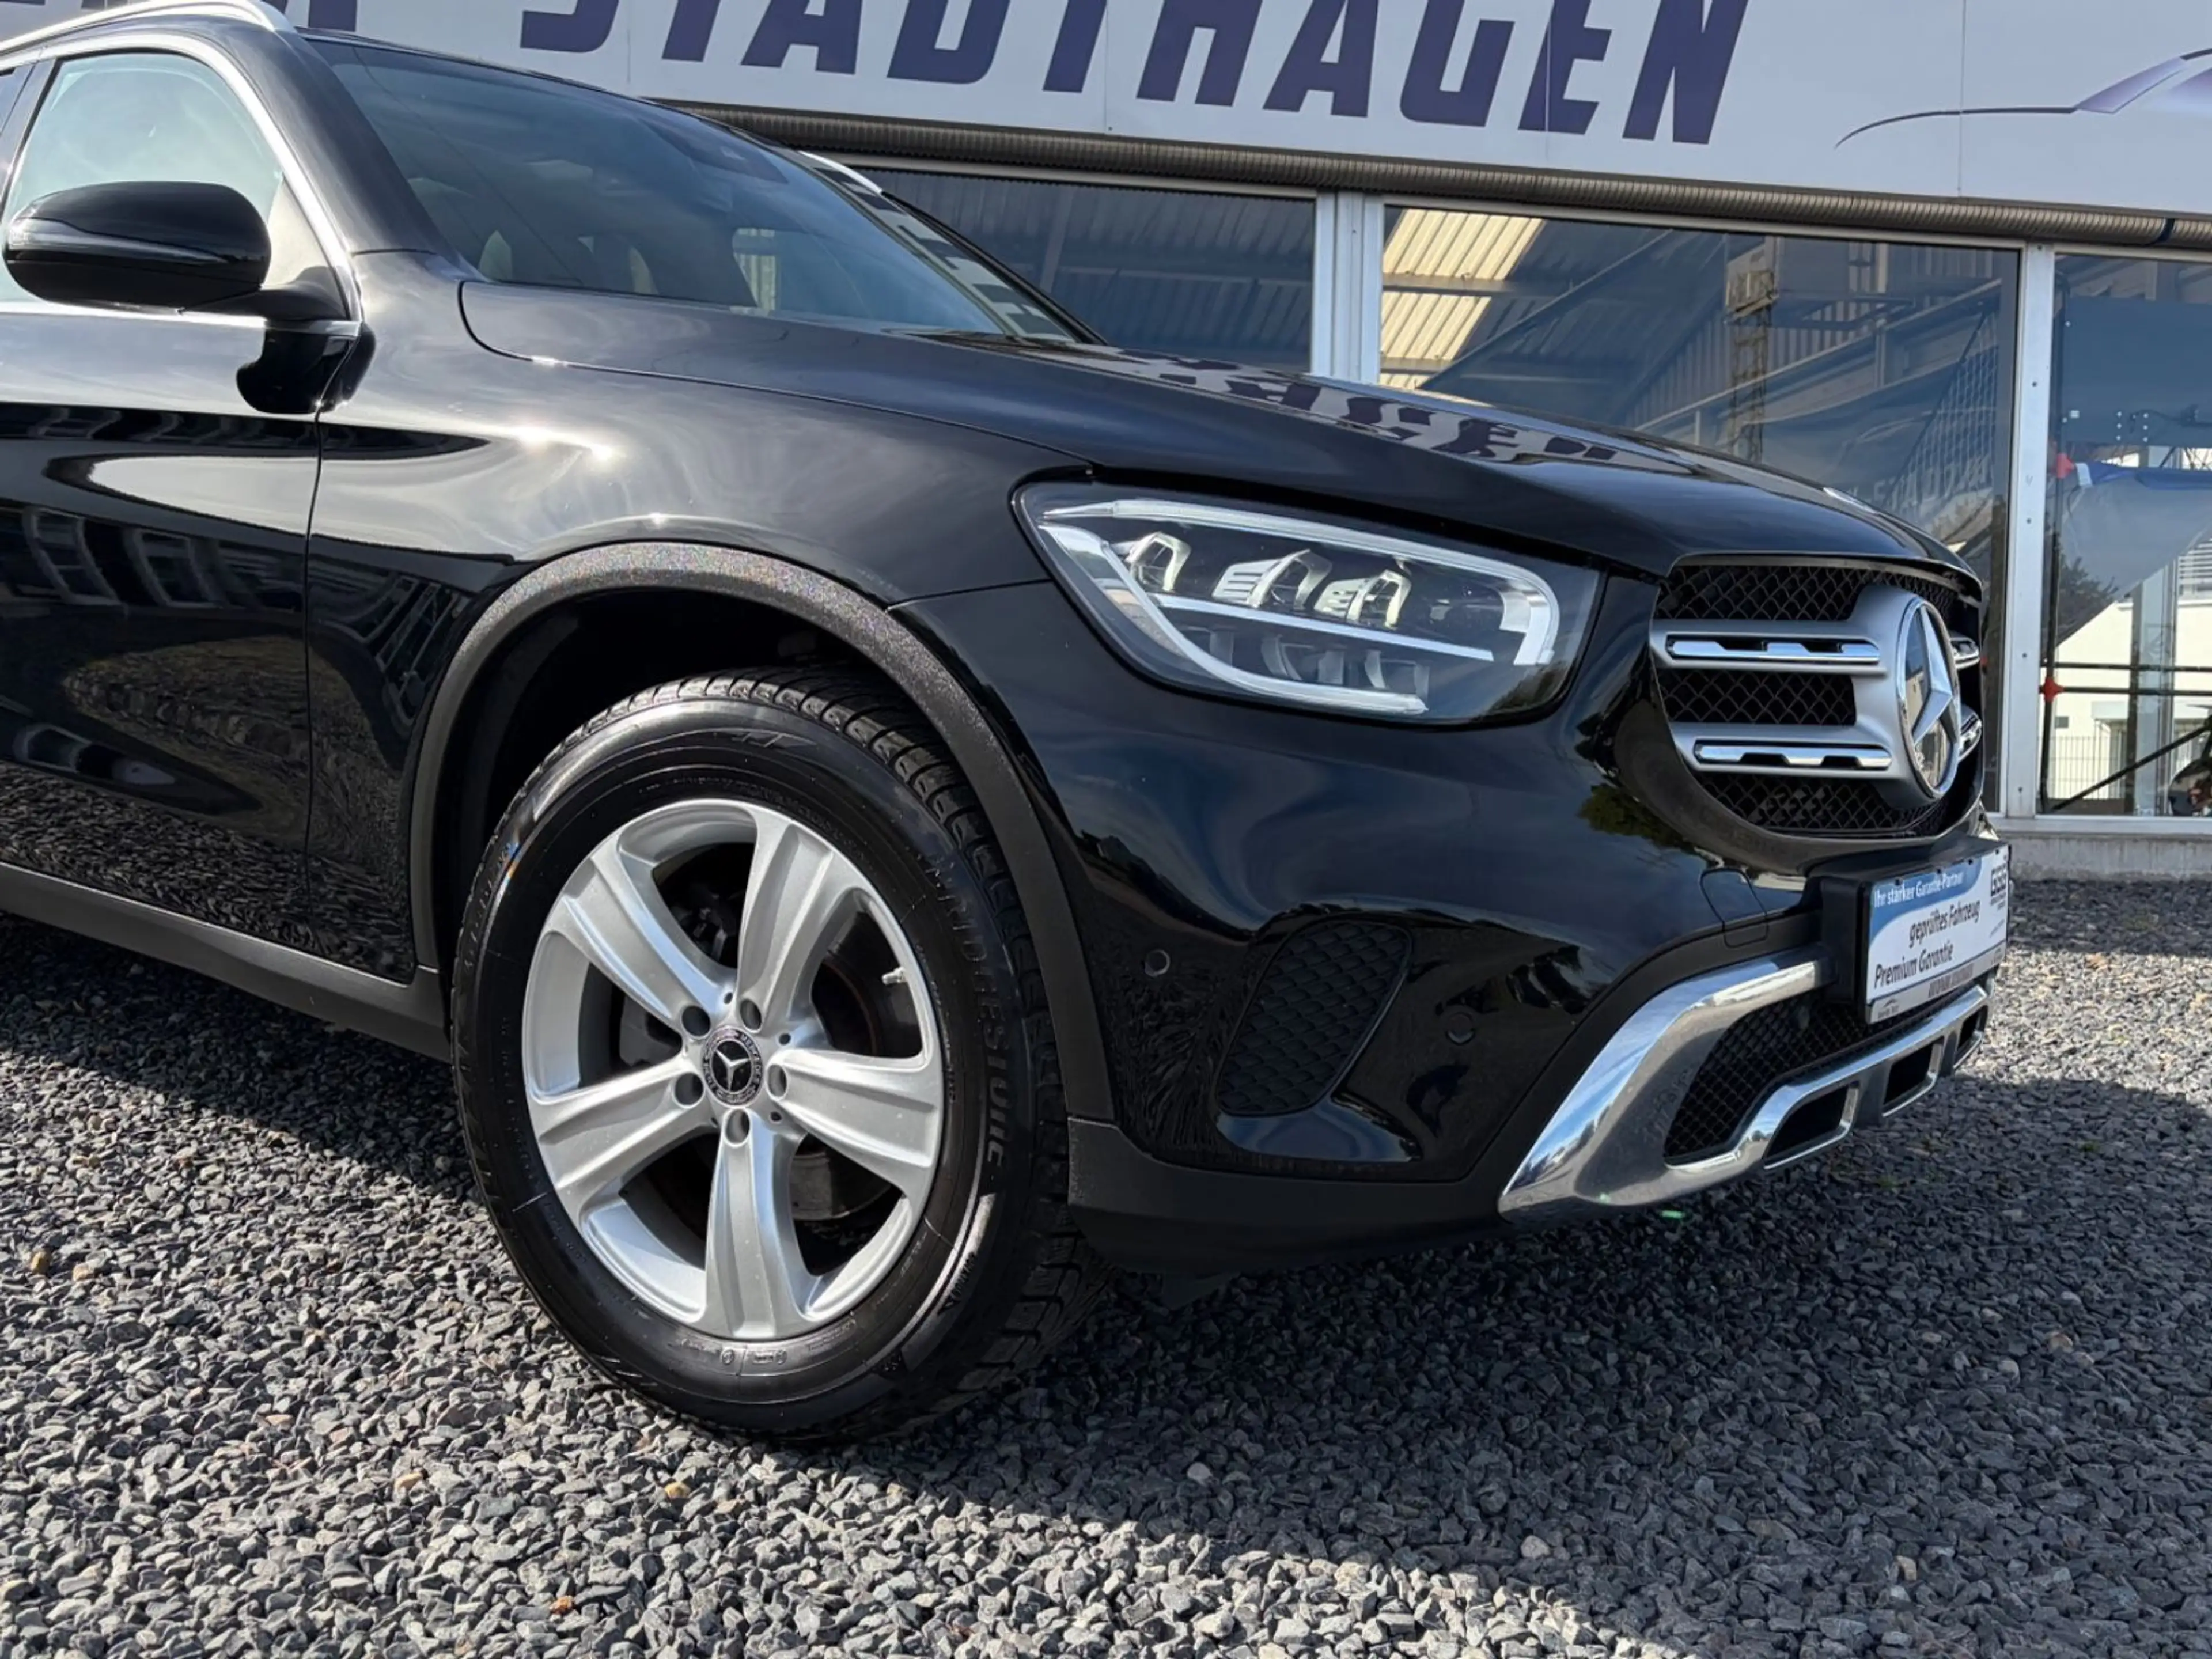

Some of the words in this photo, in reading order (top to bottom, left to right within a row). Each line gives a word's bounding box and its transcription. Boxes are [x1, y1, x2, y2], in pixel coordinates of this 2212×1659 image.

[520, 0, 1748, 144] HAGEN
[1874, 889, 1887, 908] Ihr
[1887, 882, 1915, 905] starker
[1874, 956, 1917, 989] Premium
[1919, 940, 1953, 972] Garantie
